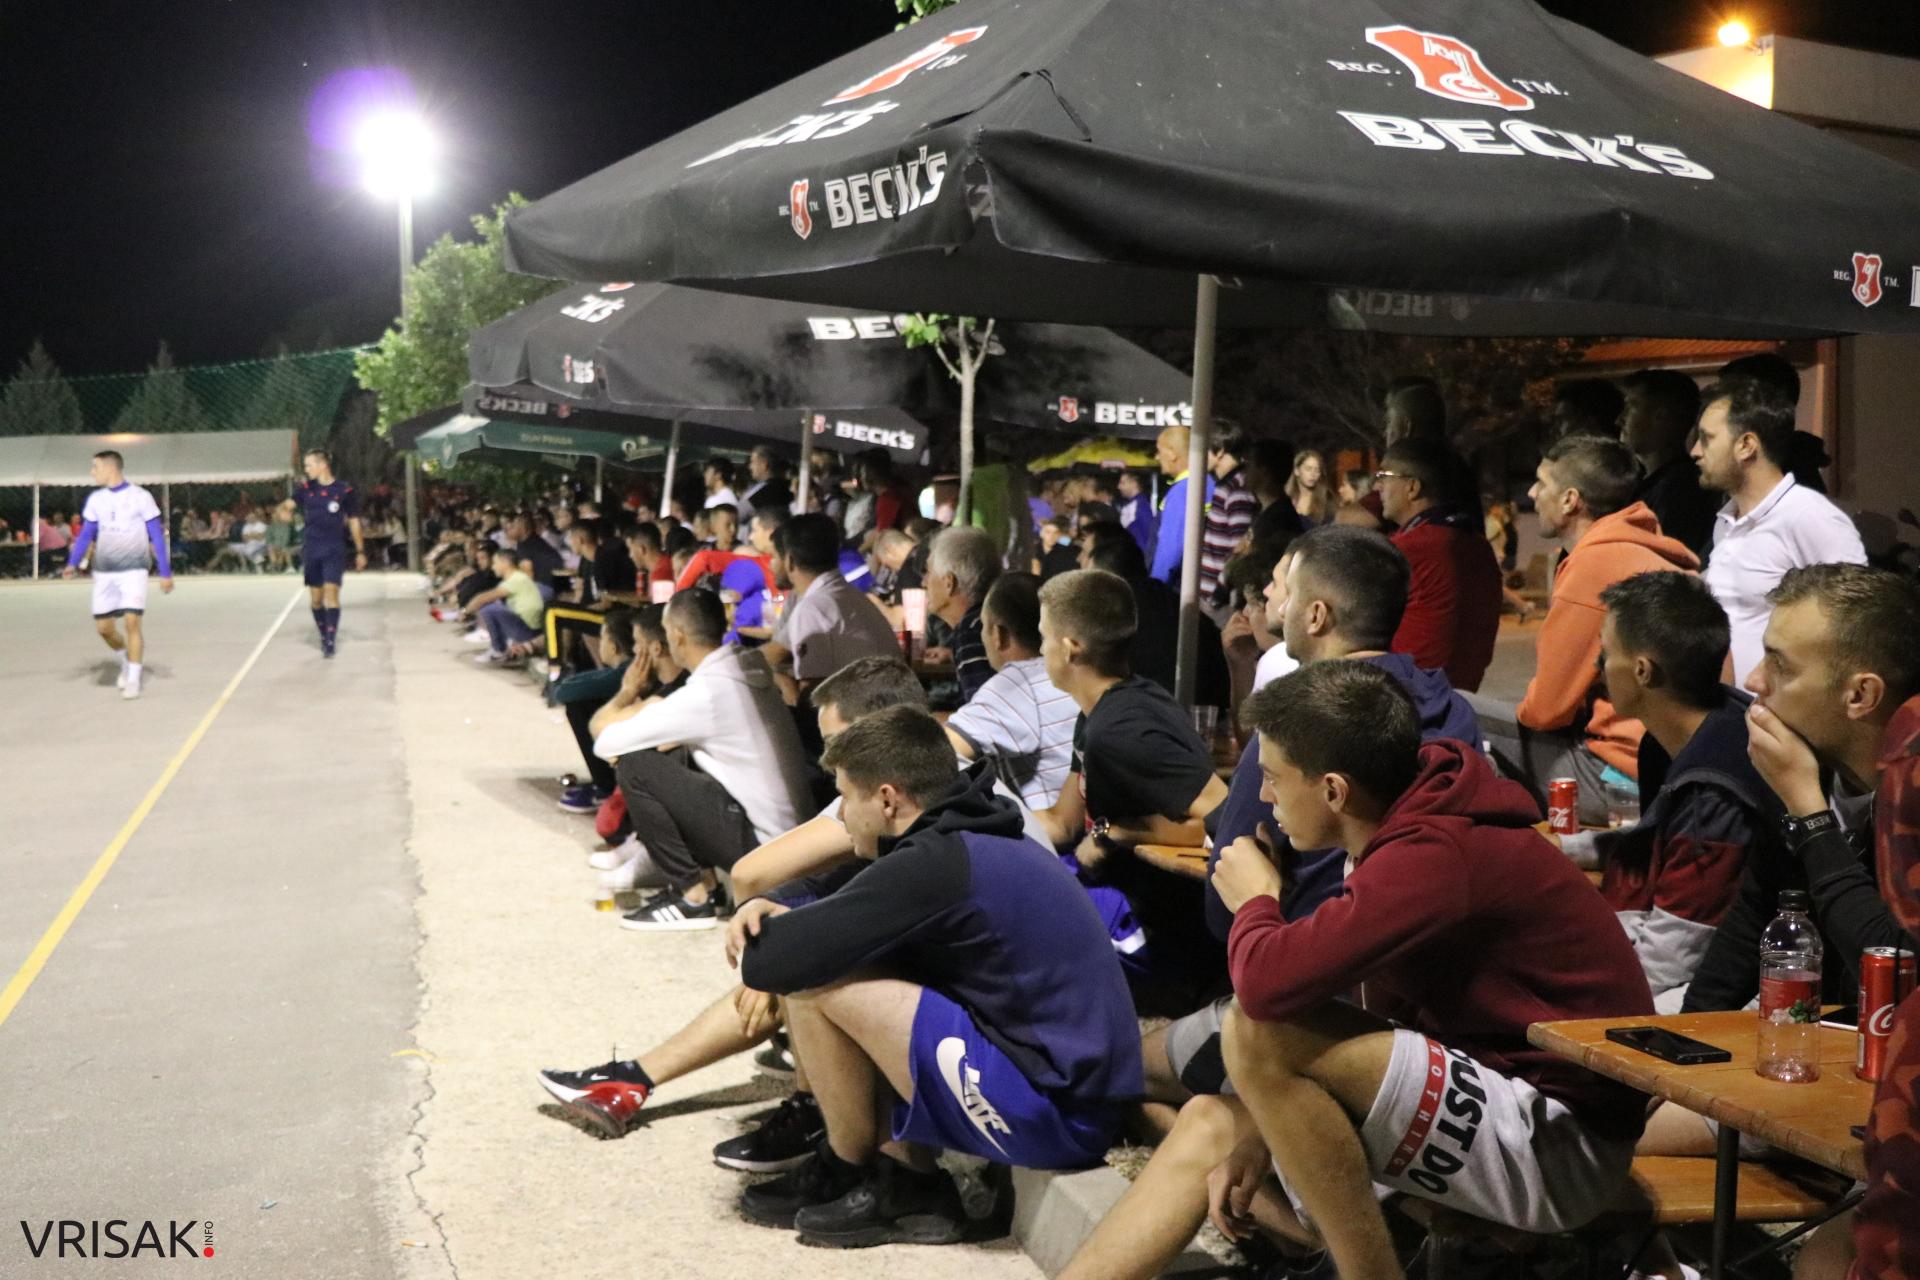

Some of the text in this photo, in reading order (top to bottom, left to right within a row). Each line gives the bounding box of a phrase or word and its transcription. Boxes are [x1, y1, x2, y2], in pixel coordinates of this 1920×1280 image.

[1336, 110, 1716, 181] BECK'S
[824, 145, 948, 229] BECK'S
[835, 420, 916, 450] BECK'S
[1407, 1142, 1465, 1196] DO
